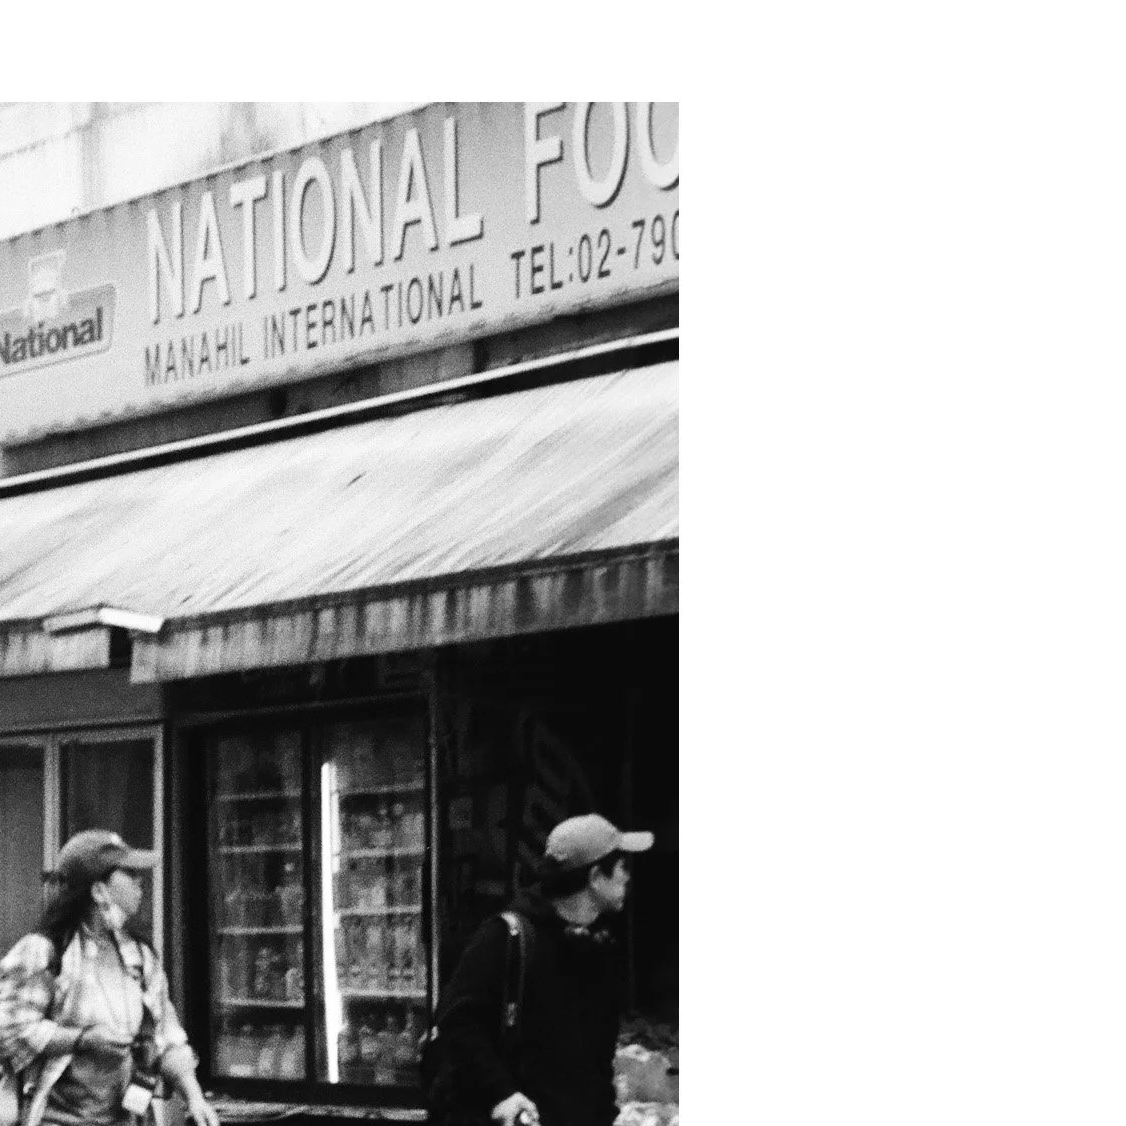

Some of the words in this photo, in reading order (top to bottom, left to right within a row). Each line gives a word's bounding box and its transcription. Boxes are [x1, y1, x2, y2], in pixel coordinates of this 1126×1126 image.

[146, 116, 484, 326] NATIONAL
[144, 321, 251, 388] MANAHIL
[264, 263, 483, 360] INTERNATIONAL
